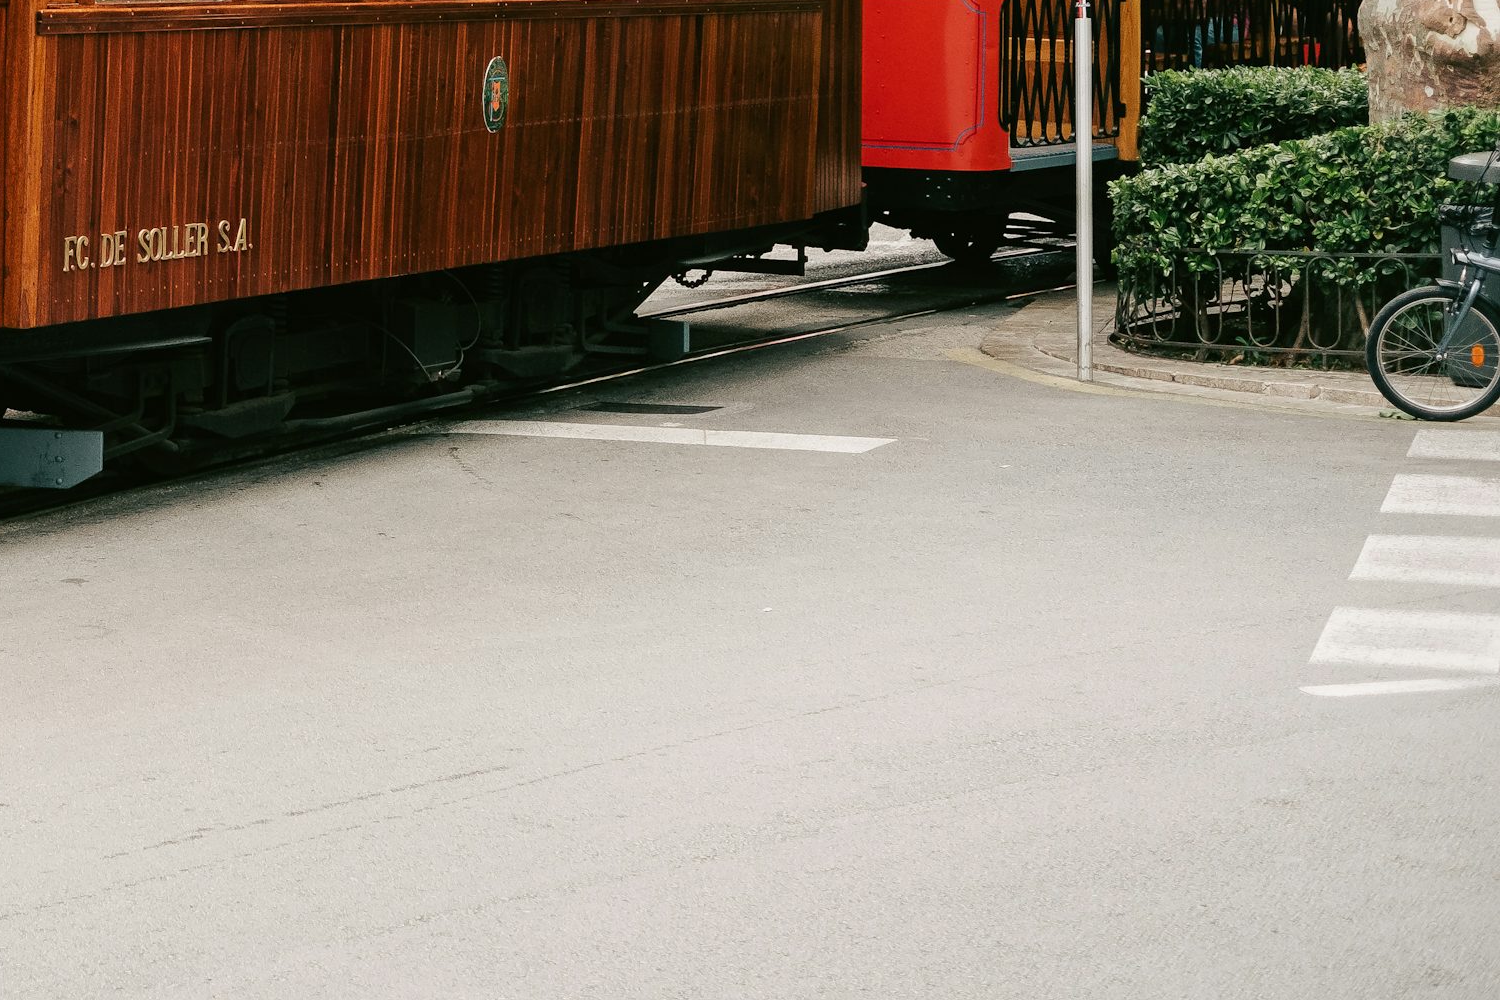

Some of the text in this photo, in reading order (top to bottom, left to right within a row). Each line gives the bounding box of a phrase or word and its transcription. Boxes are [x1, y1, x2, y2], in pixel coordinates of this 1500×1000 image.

[100, 230, 127, 268] DE
[137, 222, 209, 263] SOLLER
[217, 217, 254, 254] S.A.
